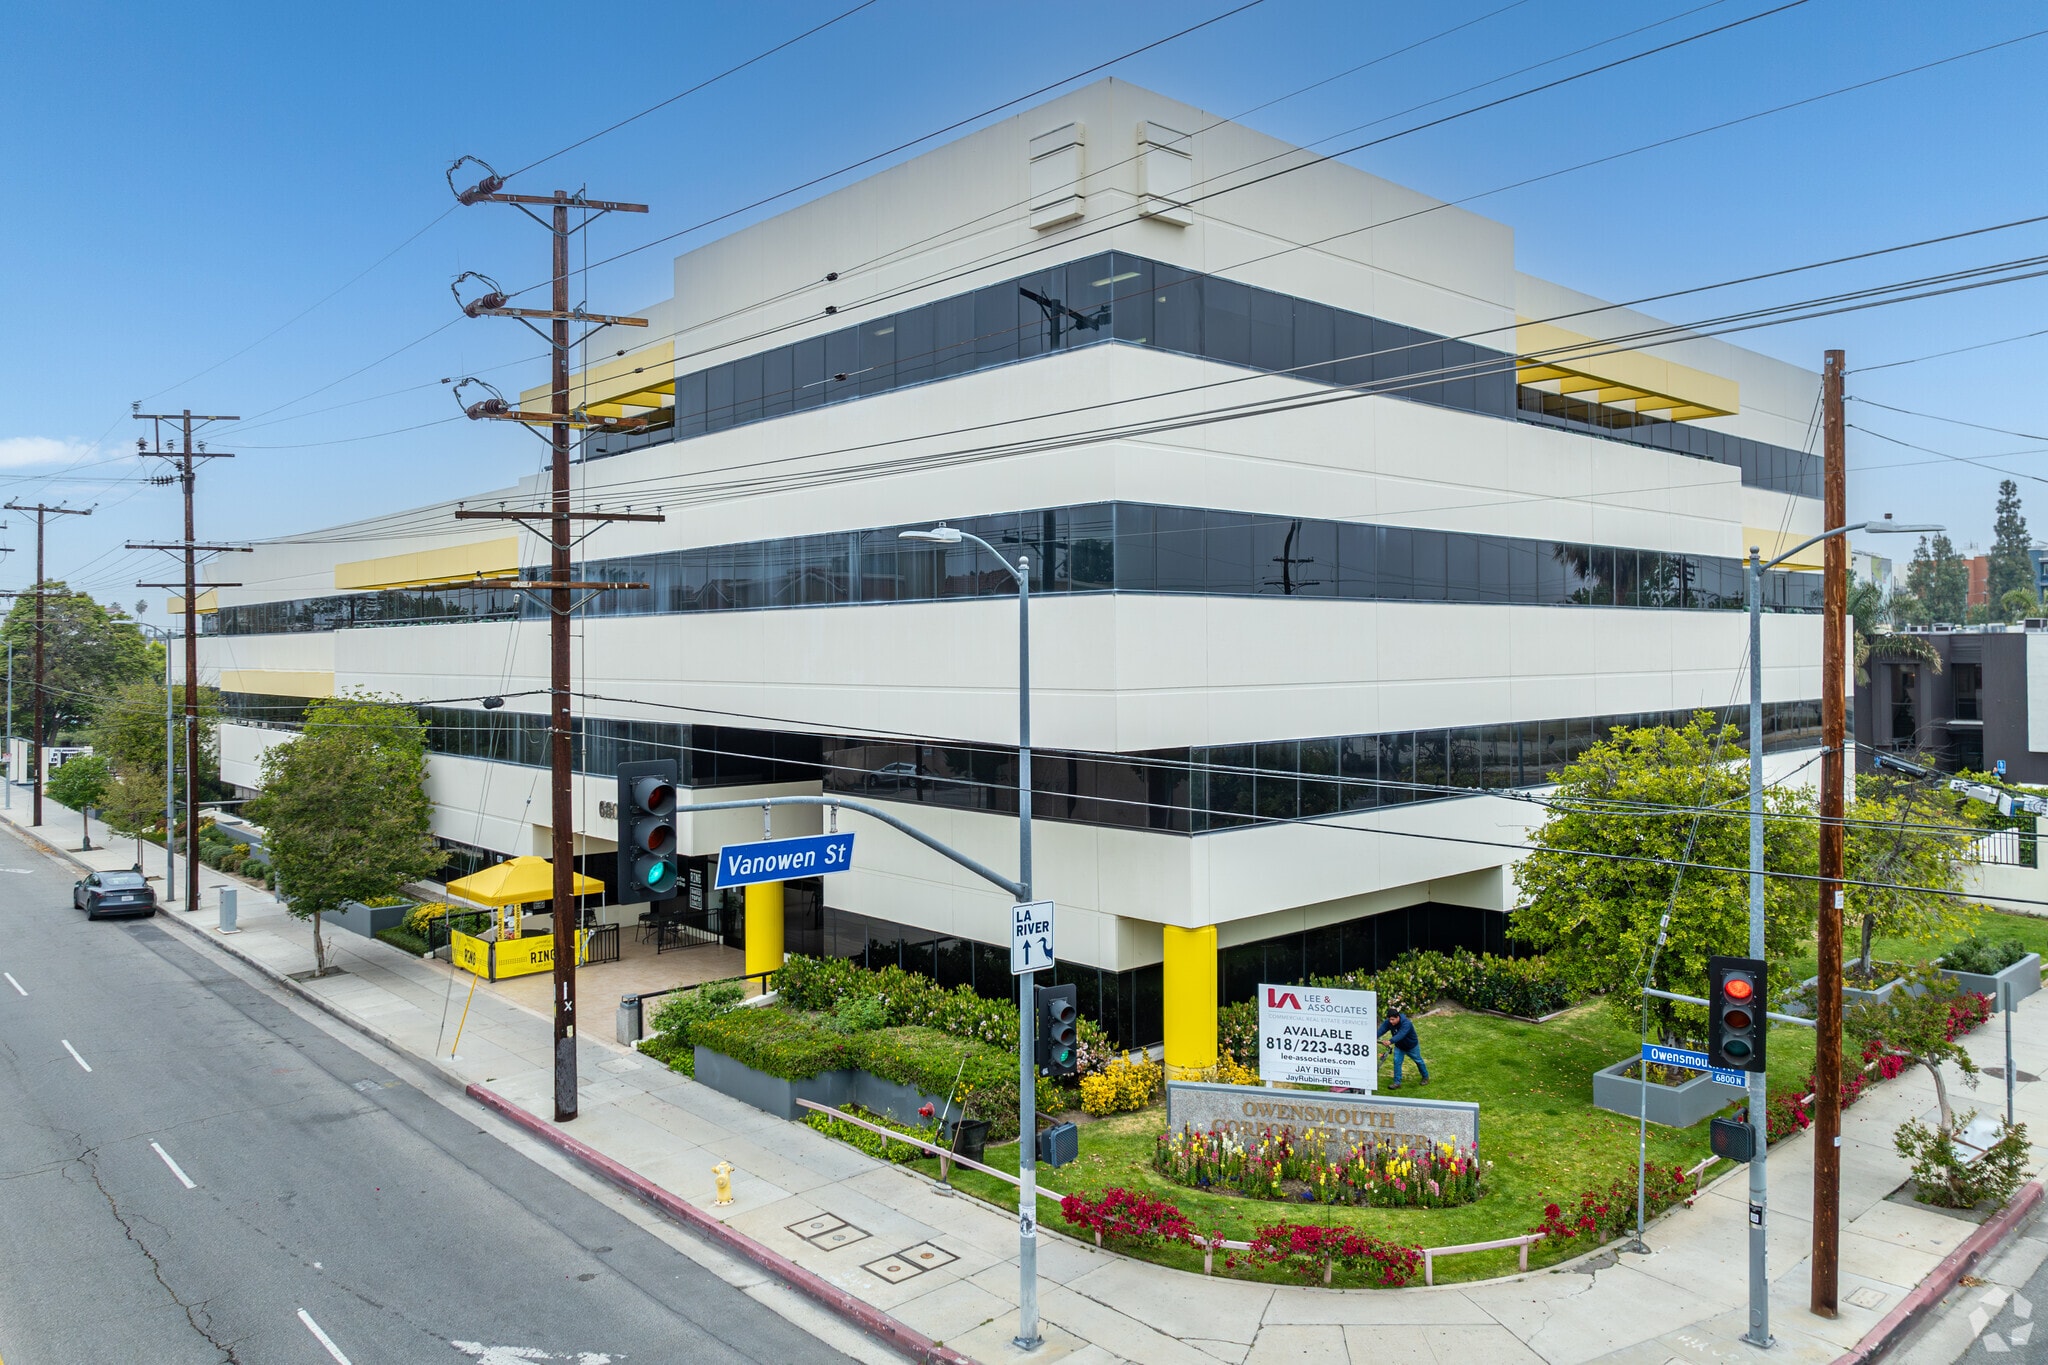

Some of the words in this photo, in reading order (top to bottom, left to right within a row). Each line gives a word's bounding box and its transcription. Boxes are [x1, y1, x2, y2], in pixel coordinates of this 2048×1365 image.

[729, 851, 816, 876] Vanowen
[824, 843, 846, 864] St
[1016, 910, 1032, 923] LA
[1016, 920, 1049, 937] RIVER
[1304, 994, 1320, 1002] LEE
[1307, 1004, 1368, 1015] ASSOCIATES
[1268, 1014, 1305, 1022] COMMERCIAL
[1283, 1026, 1353, 1040] AVAILABLE
[1266, 1036, 1370, 1057] 818/223-4388
[1281, 1053, 1356, 1066] lee-associates.com
[1651, 1048, 1719, 1069] Owensmou
[1313, 1067, 1340, 1076] RUBIN
[1286, 1074, 1351, 1086] JayRubin-RE.com
[1715, 1074, 1735, 1084] 6800
[1242, 1101, 1395, 1128] OWENSMOUTH
[1344, 1129, 1430, 1151] CENTER
